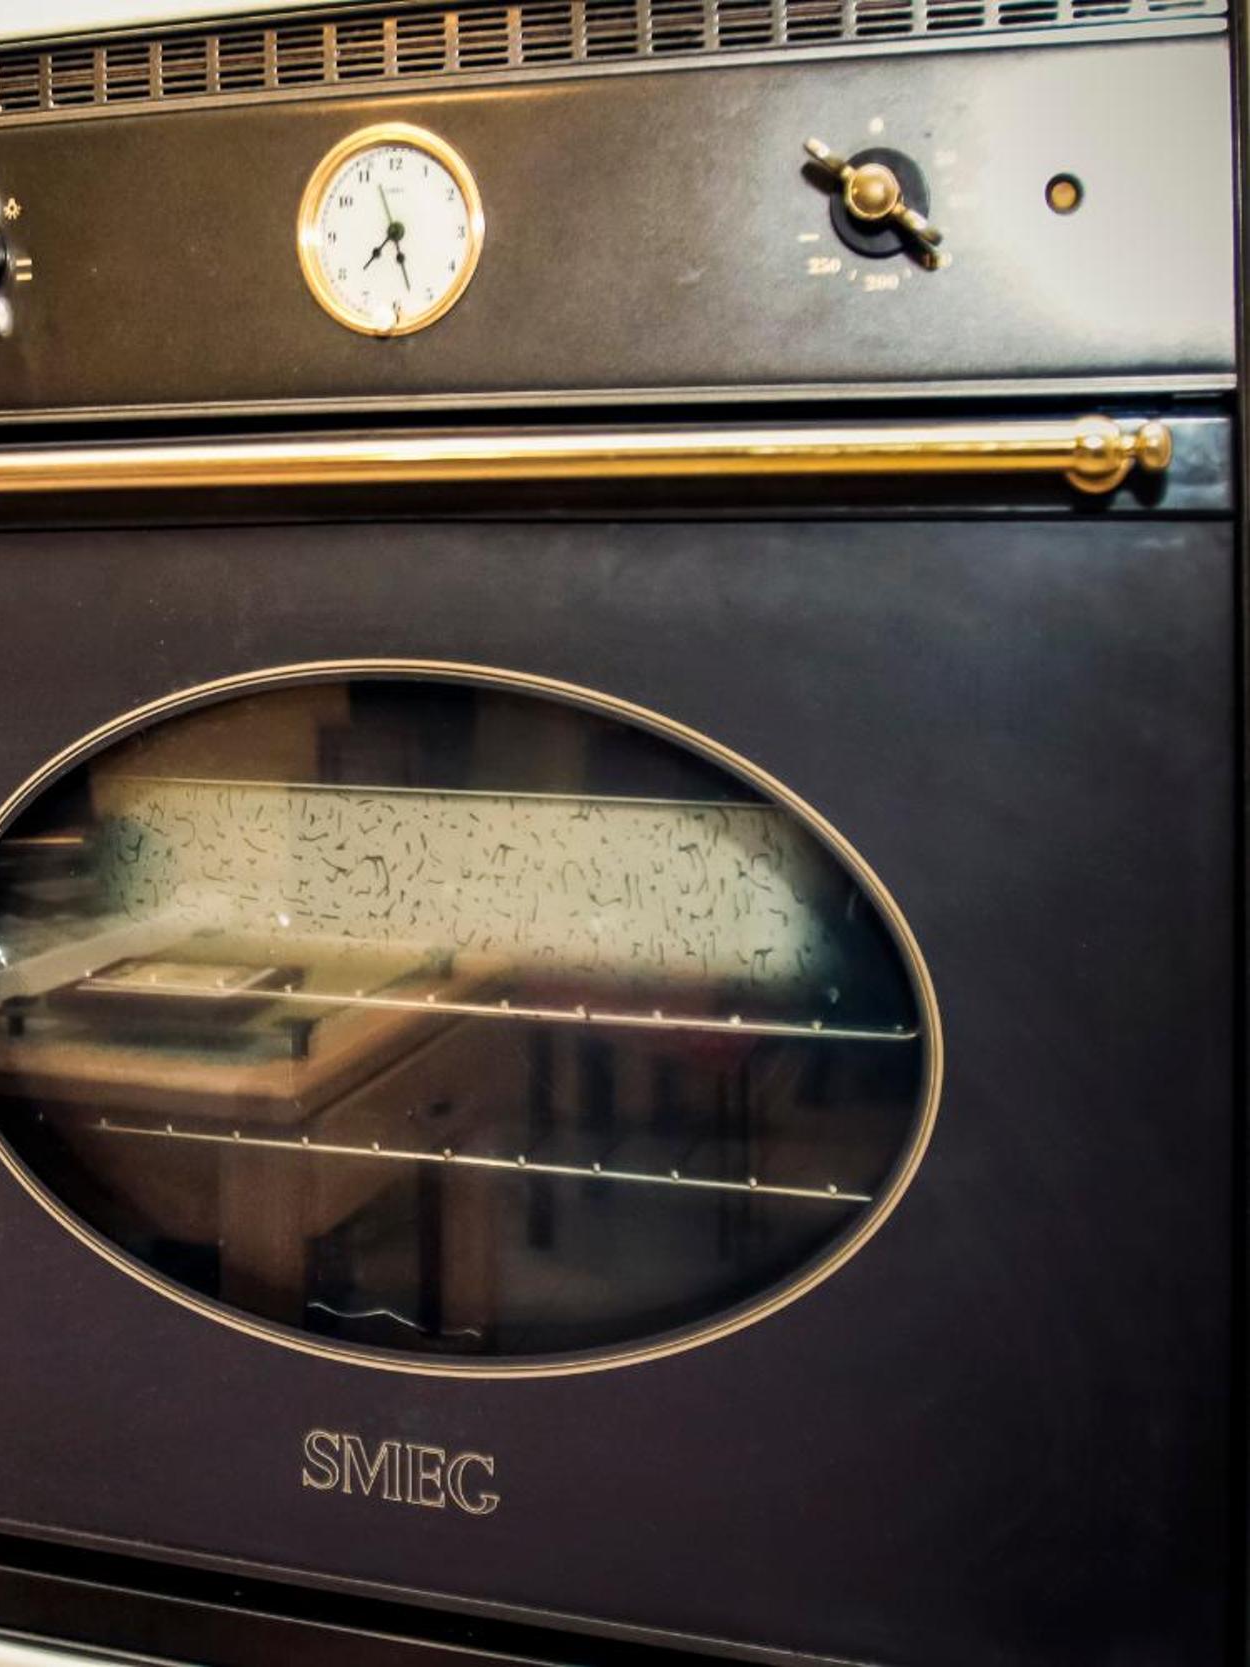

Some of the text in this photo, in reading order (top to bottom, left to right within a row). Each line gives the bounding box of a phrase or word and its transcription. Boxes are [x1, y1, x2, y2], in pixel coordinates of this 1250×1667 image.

[389, 158, 403, 171] 12
[358, 169, 370, 183] 11
[339, 196, 353, 209] 10
[328, 231, 337, 245] 9
[338, 268, 347, 281] 8
[302, 1430, 501, 1515] SMEG
